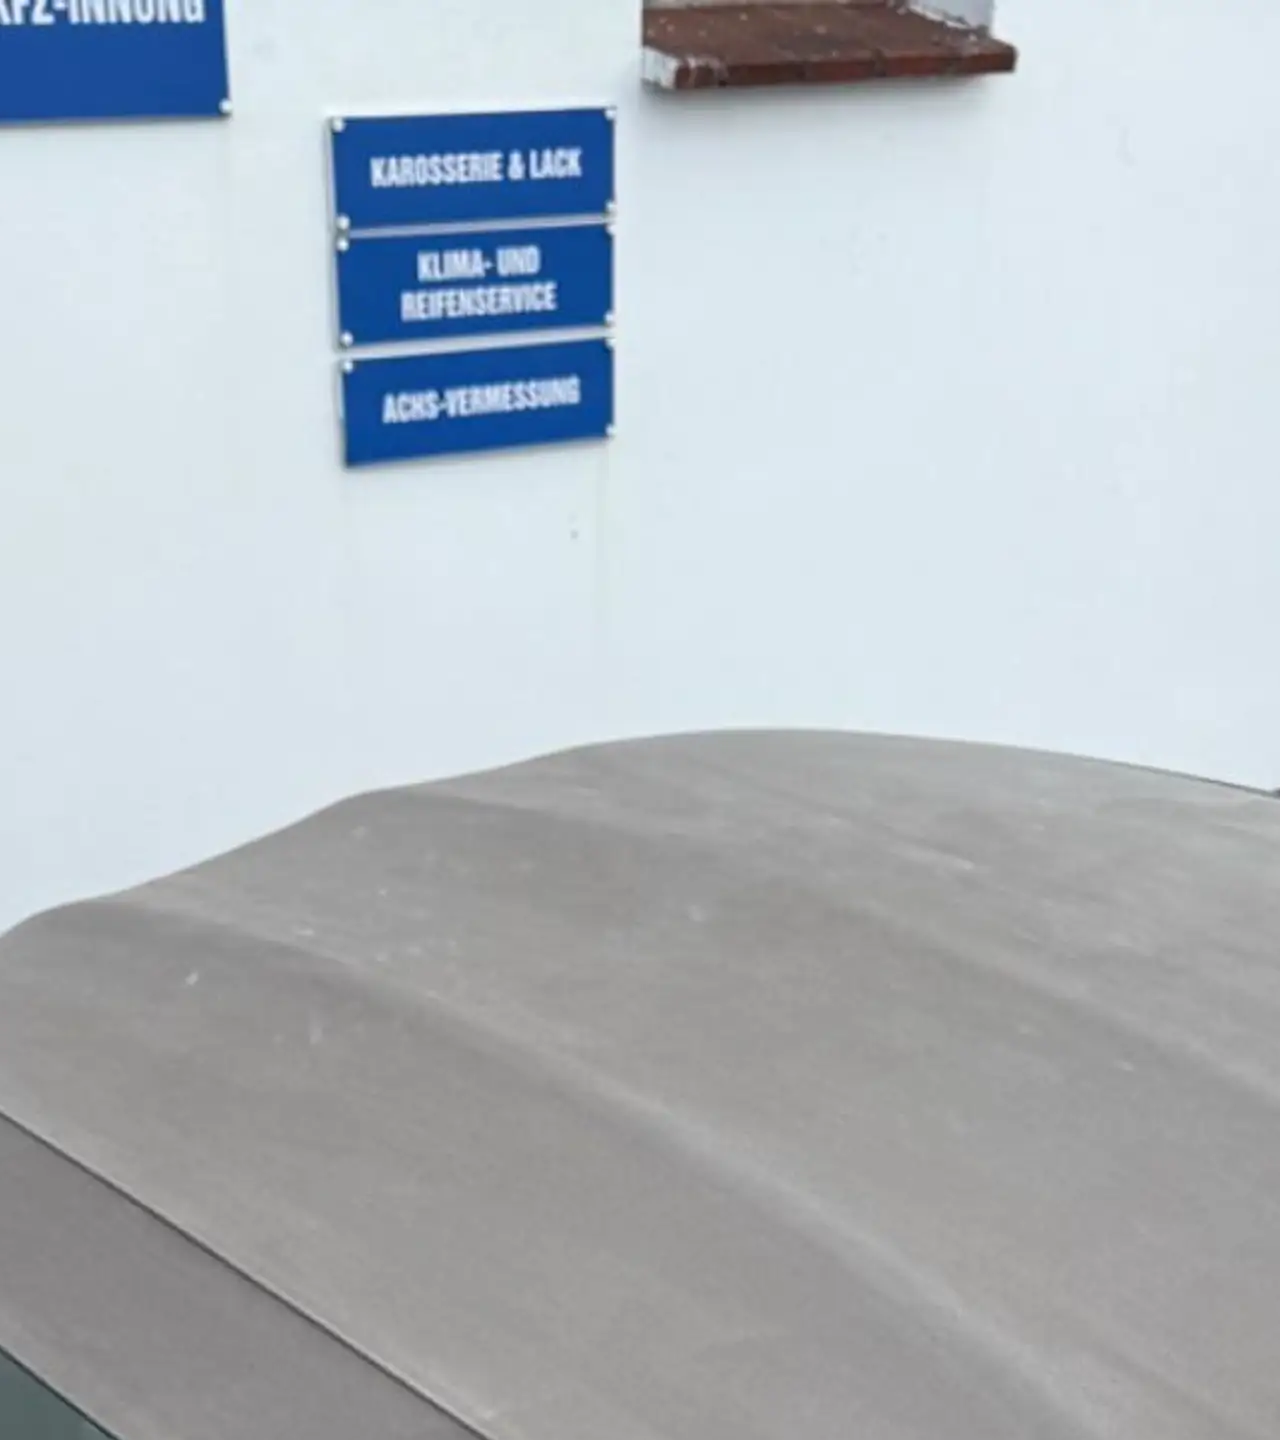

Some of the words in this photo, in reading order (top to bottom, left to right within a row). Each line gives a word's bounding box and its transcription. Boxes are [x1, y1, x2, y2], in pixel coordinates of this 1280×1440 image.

[370, 154, 503, 188] KAROSSERIE
[507, 151, 524, 181] &
[529, 148, 582, 180] LACK
[417, 250, 494, 282] KLIMA-
[496, 245, 540, 277] UND
[400, 282, 557, 322] REIFENSERVICE
[382, 376, 581, 424] ACHS-VERMESSUNG
